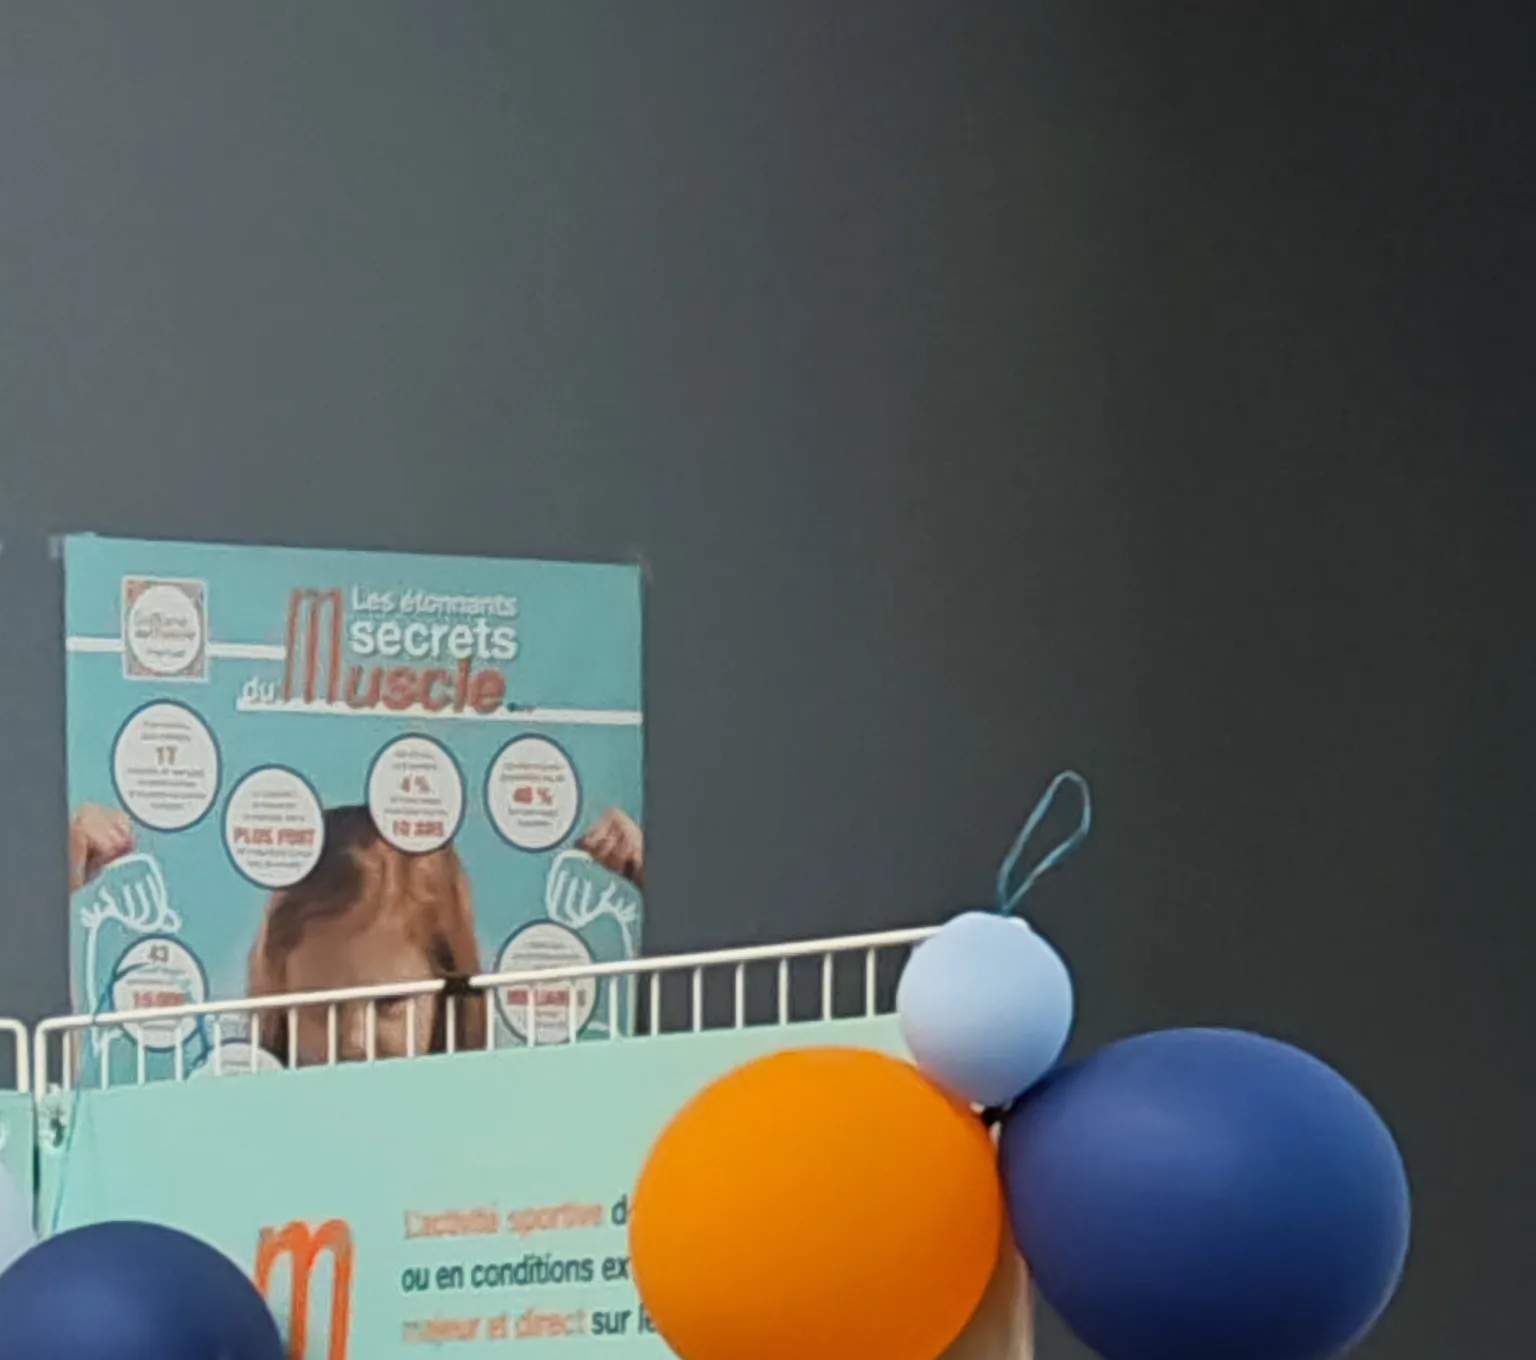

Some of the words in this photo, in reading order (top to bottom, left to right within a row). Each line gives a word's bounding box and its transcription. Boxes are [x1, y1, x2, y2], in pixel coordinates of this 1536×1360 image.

[351, 584, 392, 612] Les
[350, 616, 518, 660] secrets
[242, 676, 277, 704] du
[611, 1194, 631, 1226] d
[401, 1266, 430, 1293] ou
[435, 1264, 464, 1290] en
[471, 1252, 594, 1288] conditions
[601, 1256, 632, 1282] ex
[591, 1309, 633, 1335] sur
